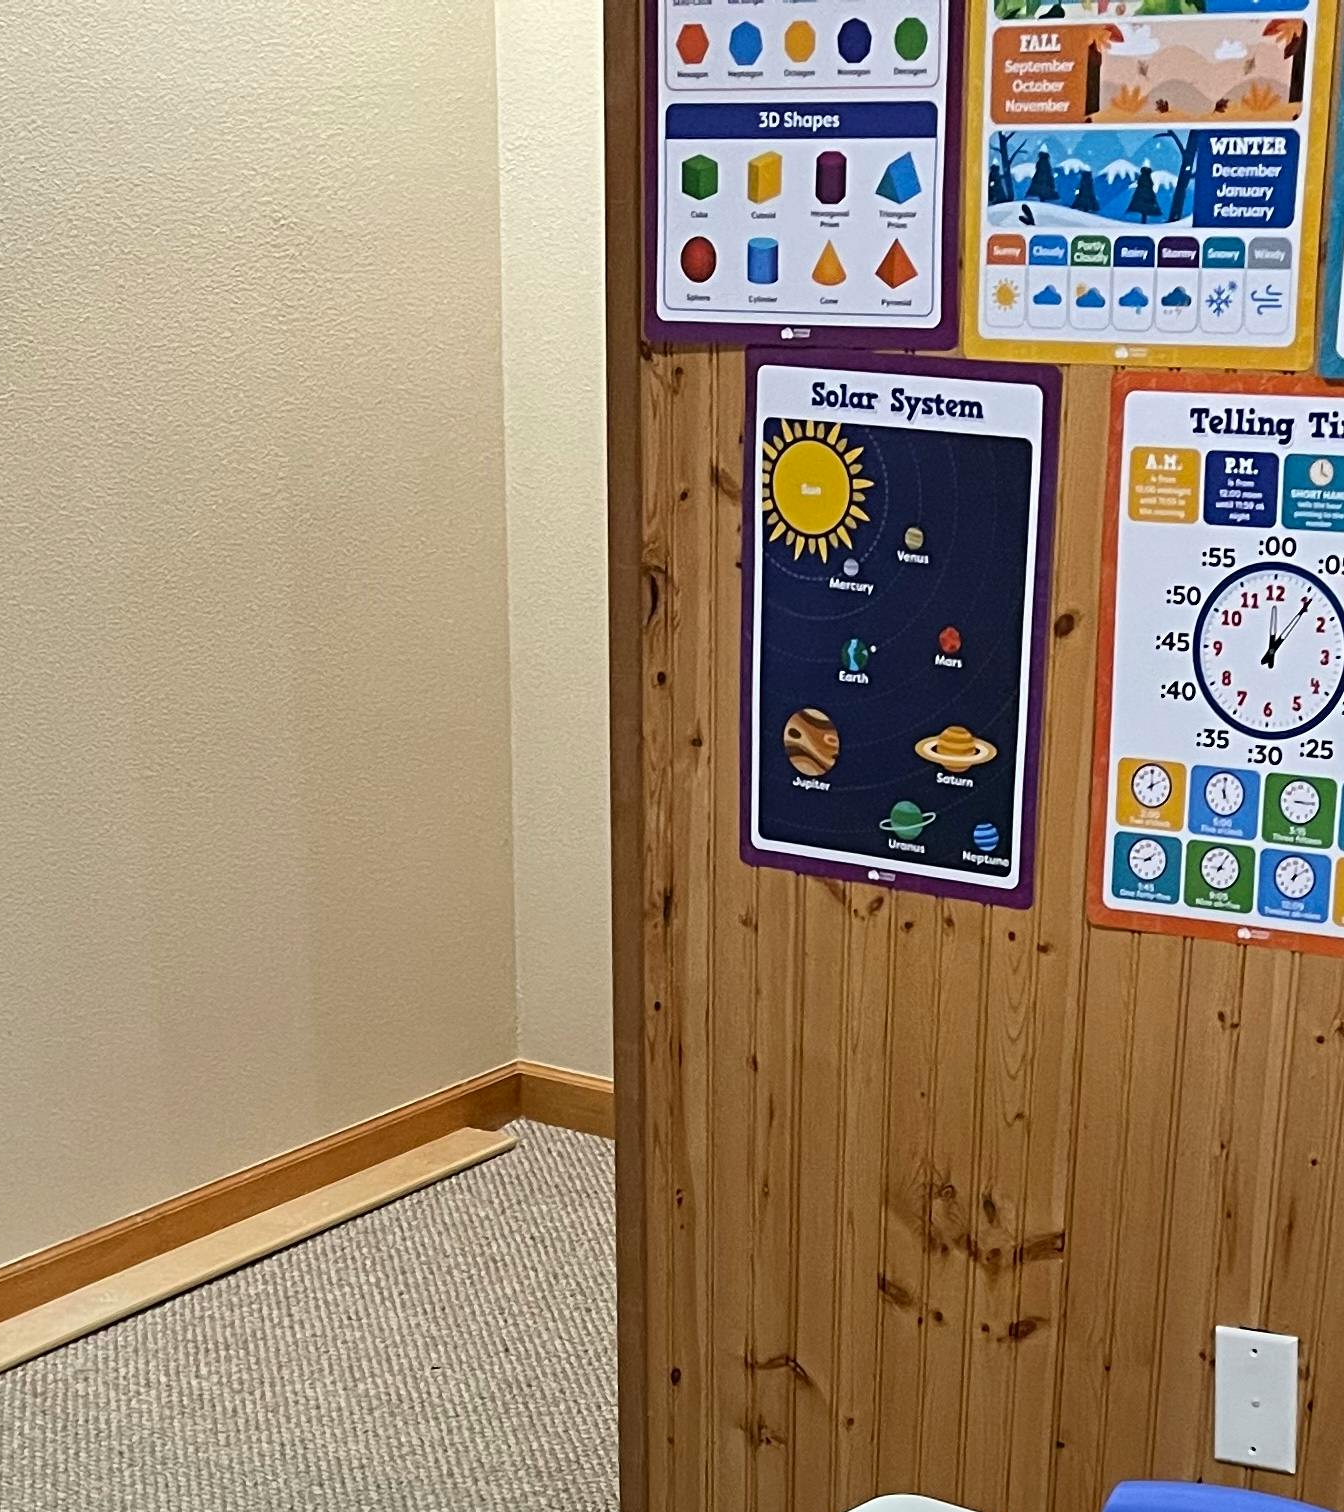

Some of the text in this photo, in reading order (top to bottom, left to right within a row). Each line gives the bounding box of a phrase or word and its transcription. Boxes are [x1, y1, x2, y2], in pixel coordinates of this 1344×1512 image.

[1020, 34, 1061, 53] FALL
[1005, 59, 1075, 76] September
[1012, 79, 1064, 93] October
[1005, 98, 1070, 112] November
[758, 111, 840, 132] 3D Shapes
[1209, 136, 1287, 155] WINTER
[1212, 163, 1282, 177] December
[1216, 183, 1274, 201] January
[1214, 203, 1275, 221] February
[811, 381, 984, 423] Solar System
[1189, 407, 1295, 445] Telling
[1145, 453, 1183, 471] A.M.
[1224, 457, 1259, 475] P.M.
[1259, 536, 1297, 558] :00
[897, 550, 929, 565] Venus
[1201, 547, 1236, 569] :55
[829, 577, 874, 596] Mercury
[1265, 585, 1286, 602] 12
[1166, 586, 1201, 606] :50
[1241, 592, 1259, 610] 11
[1221, 610, 1242, 627] 10
[1315, 617, 1326, 634] 2
[1155, 632, 1190, 652] :45
[1213, 641, 1223, 656] 9
[935, 654, 963, 669] Mars
[1319, 649, 1330, 666] 3
[839, 671, 869, 685] Earth
[1222, 671, 1233, 687] 8
[1310, 678, 1320, 695] 4
[1160, 681, 1196, 701] :40
[1237, 691, 1247, 707] 7
[1263, 702, 1273, 717] 6
[1292, 696, 1302, 712] 5
[1196, 729, 1230, 750] :35
[1247, 745, 1283, 767] :30
[1299, 739, 1334, 761] :25
[792, 776, 831, 792] Jupiter
[936, 772, 974, 788] Saturn
[888, 838, 925, 854] Uranus
[962, 850, 1010, 867] Neptune
